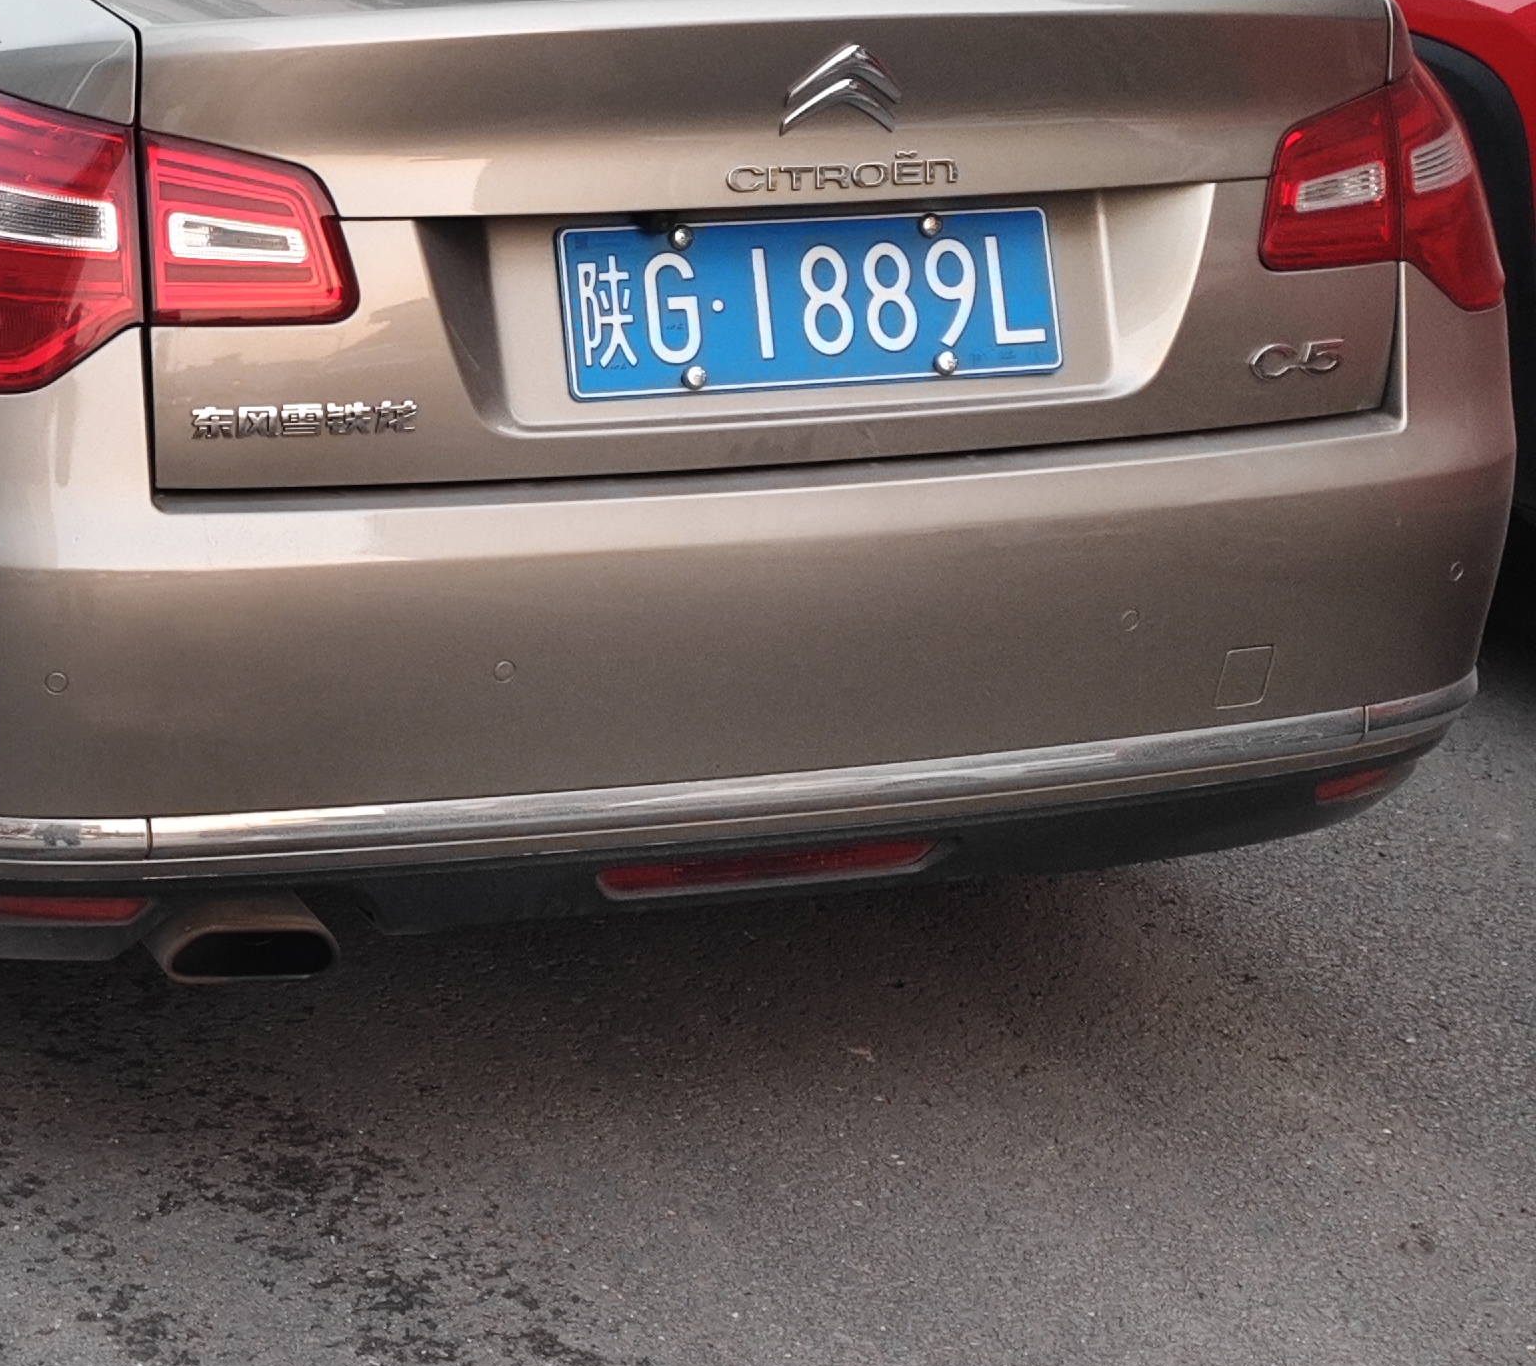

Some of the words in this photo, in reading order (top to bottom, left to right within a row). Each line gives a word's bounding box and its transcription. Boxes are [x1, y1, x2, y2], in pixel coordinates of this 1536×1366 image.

[1245, 337, 1344, 381] C5
[191, 399, 418, 440] 东风雪铁龙
